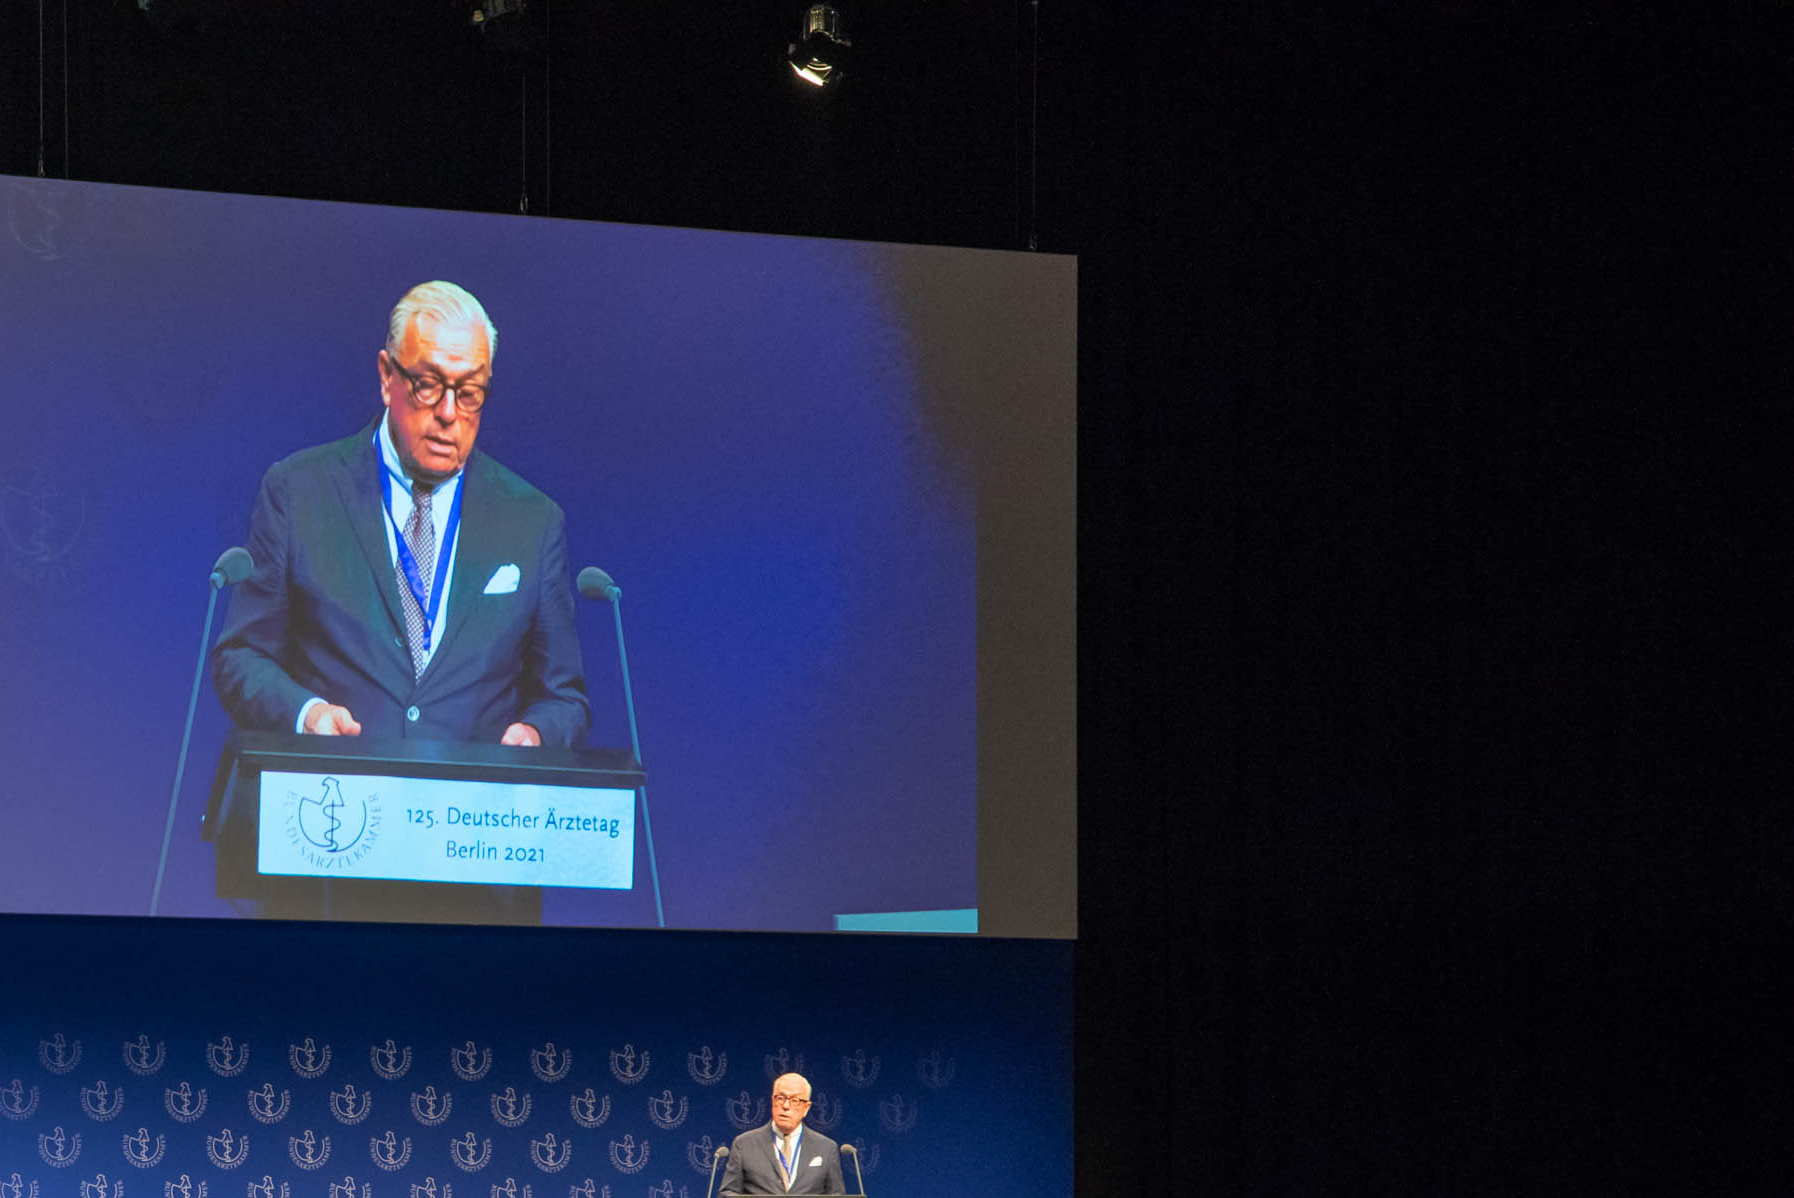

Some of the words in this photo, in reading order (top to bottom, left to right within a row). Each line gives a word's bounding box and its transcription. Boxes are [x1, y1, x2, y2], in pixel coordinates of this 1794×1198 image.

[407, 808, 439, 829] 125.
[447, 806, 540, 829] Deutscher
[545, 808, 620, 838] Ärztetag
[446, 840, 497, 860] Berlin
[505, 847, 545, 863] 2021
